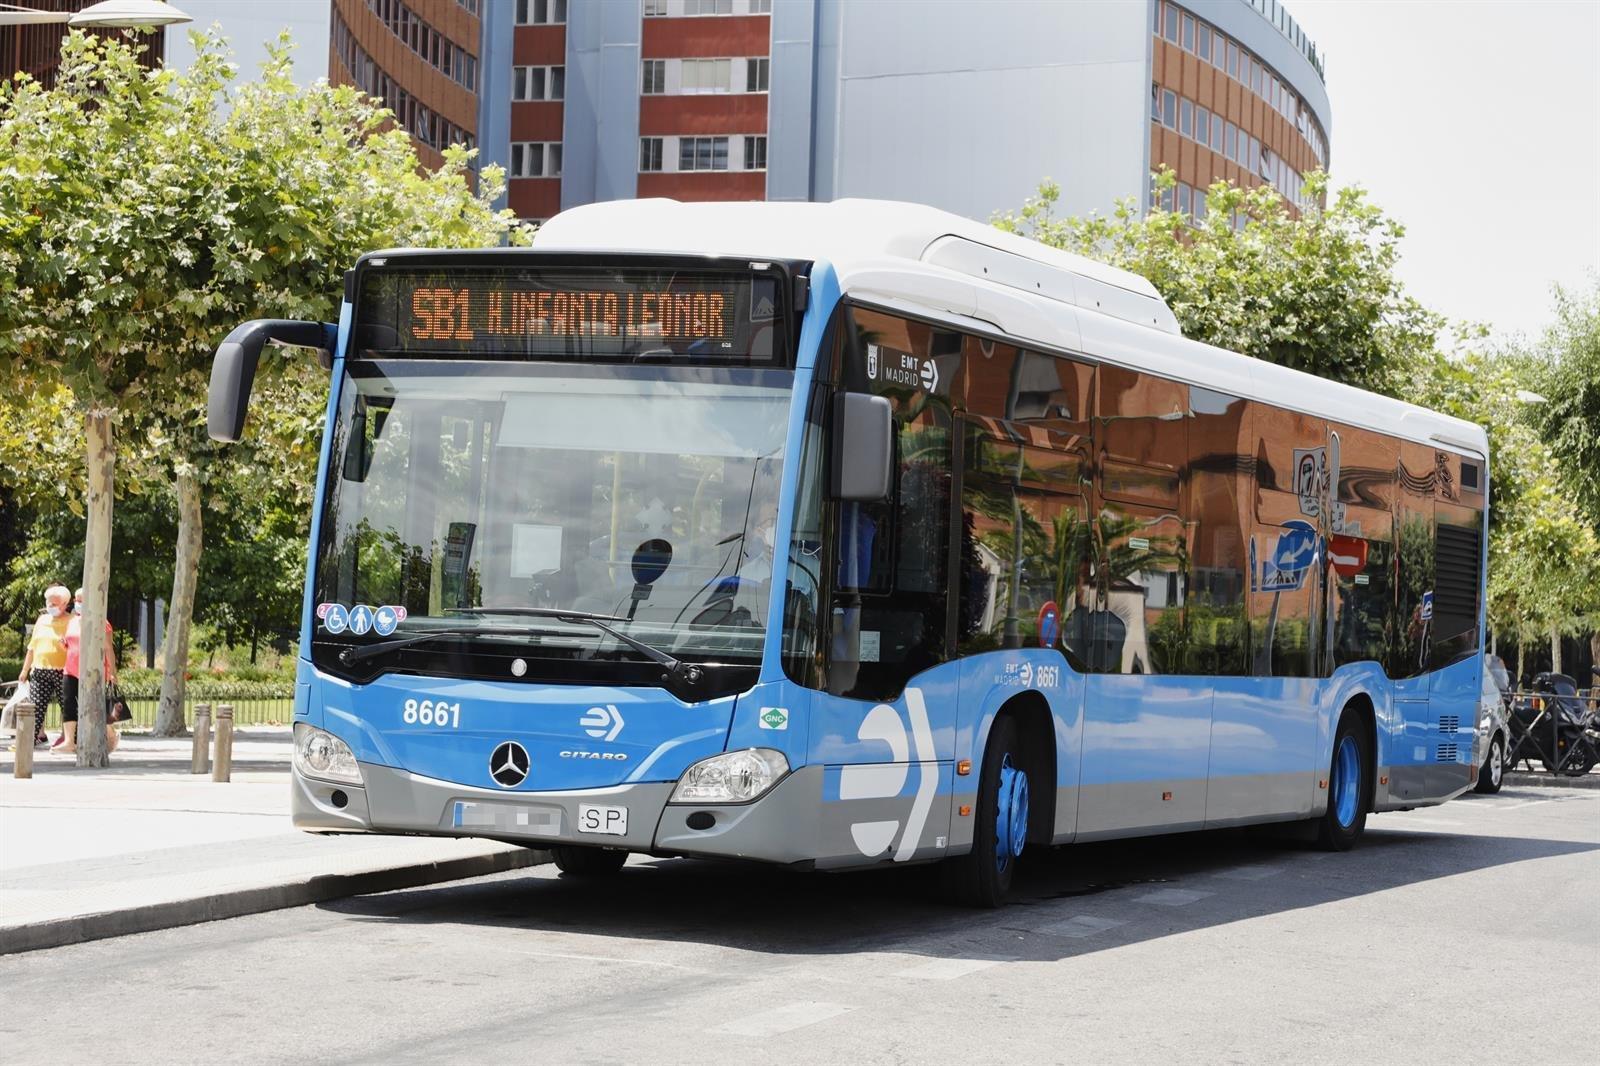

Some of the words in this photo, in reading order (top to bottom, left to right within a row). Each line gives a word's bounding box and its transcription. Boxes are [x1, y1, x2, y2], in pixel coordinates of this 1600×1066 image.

[413, 288, 474, 340] SB1
[488, 292, 617, 336] H.INFANTA
[627, 293, 724, 337] LEONOR
[901, 354, 919, 370] EMT
[885, 367, 919, 386] MADRID
[1037, 666, 1059, 687] 8661
[403, 699, 460, 728] 8661
[765, 714, 784, 723] GNC
[559, 750, 628, 761] CITARO
